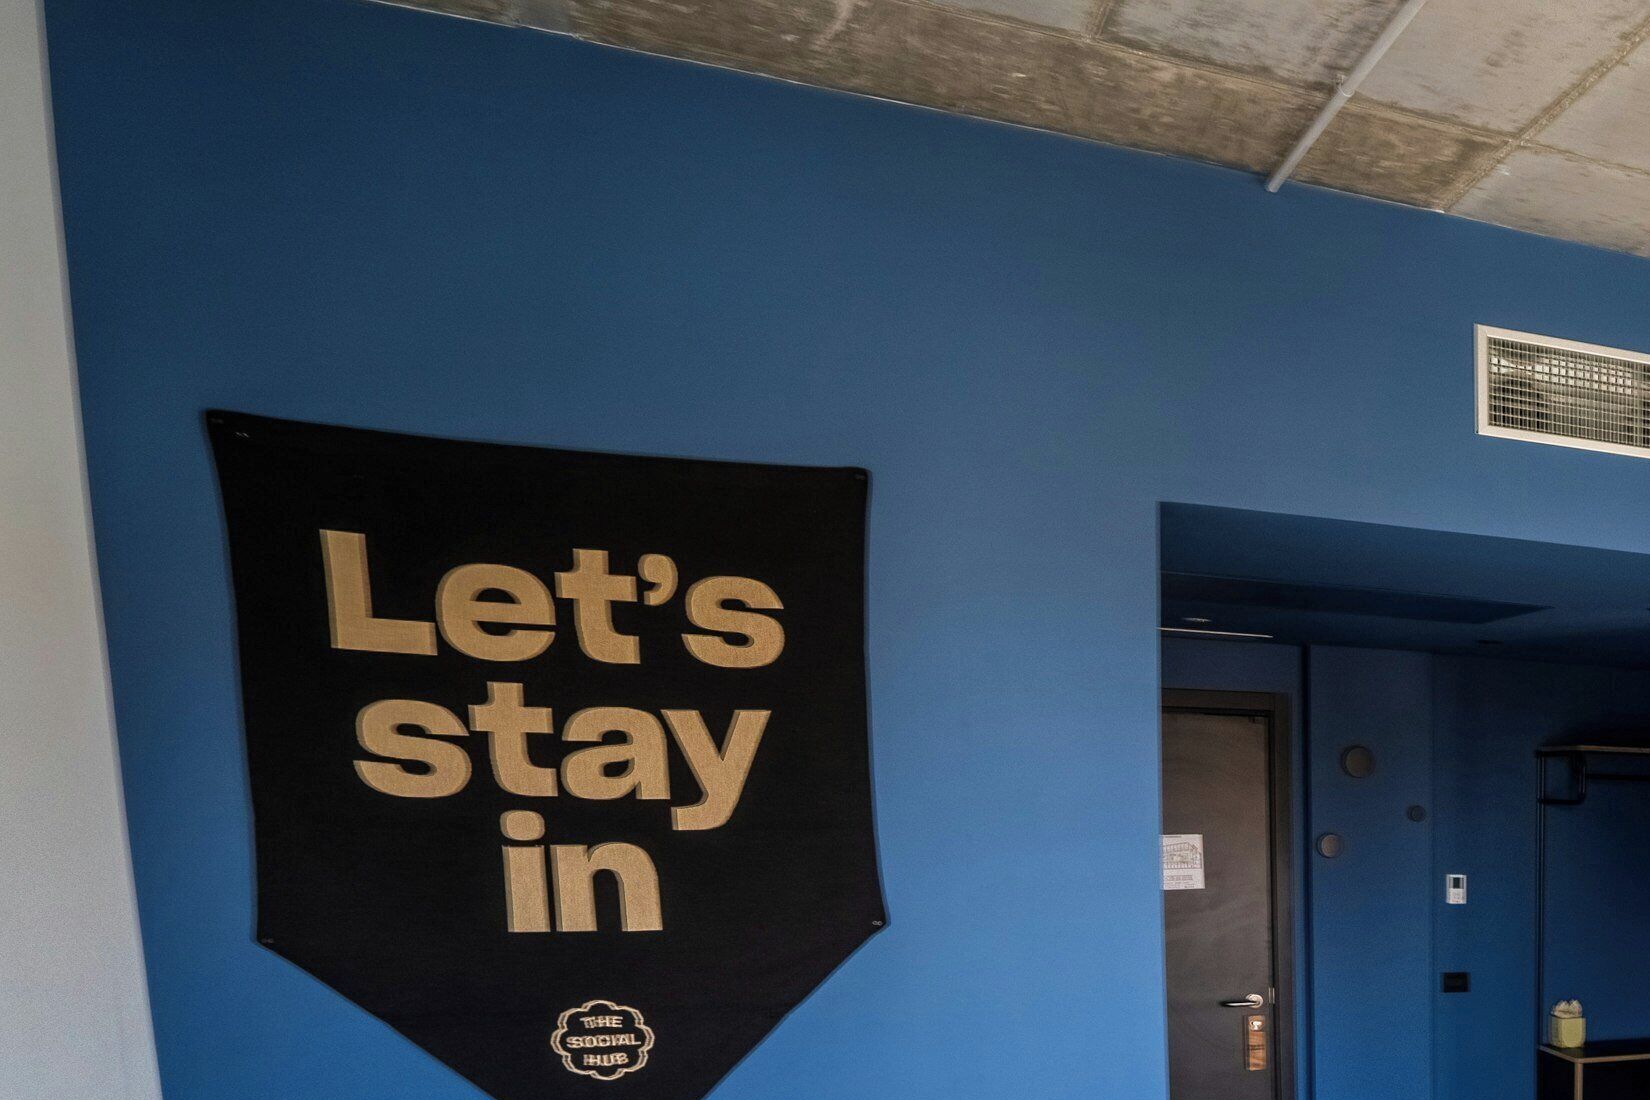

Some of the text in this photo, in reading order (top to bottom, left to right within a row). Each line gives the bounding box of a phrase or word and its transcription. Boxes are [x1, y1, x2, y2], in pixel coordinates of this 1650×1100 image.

[319, 528, 786, 668] Let’s
[352, 682, 772, 831] stay
[500, 809, 664, 933] in
[566, 1033, 642, 1049] SOCIAL
[579, 1015, 624, 1029] THE
[583, 1052, 629, 1066] HUB
